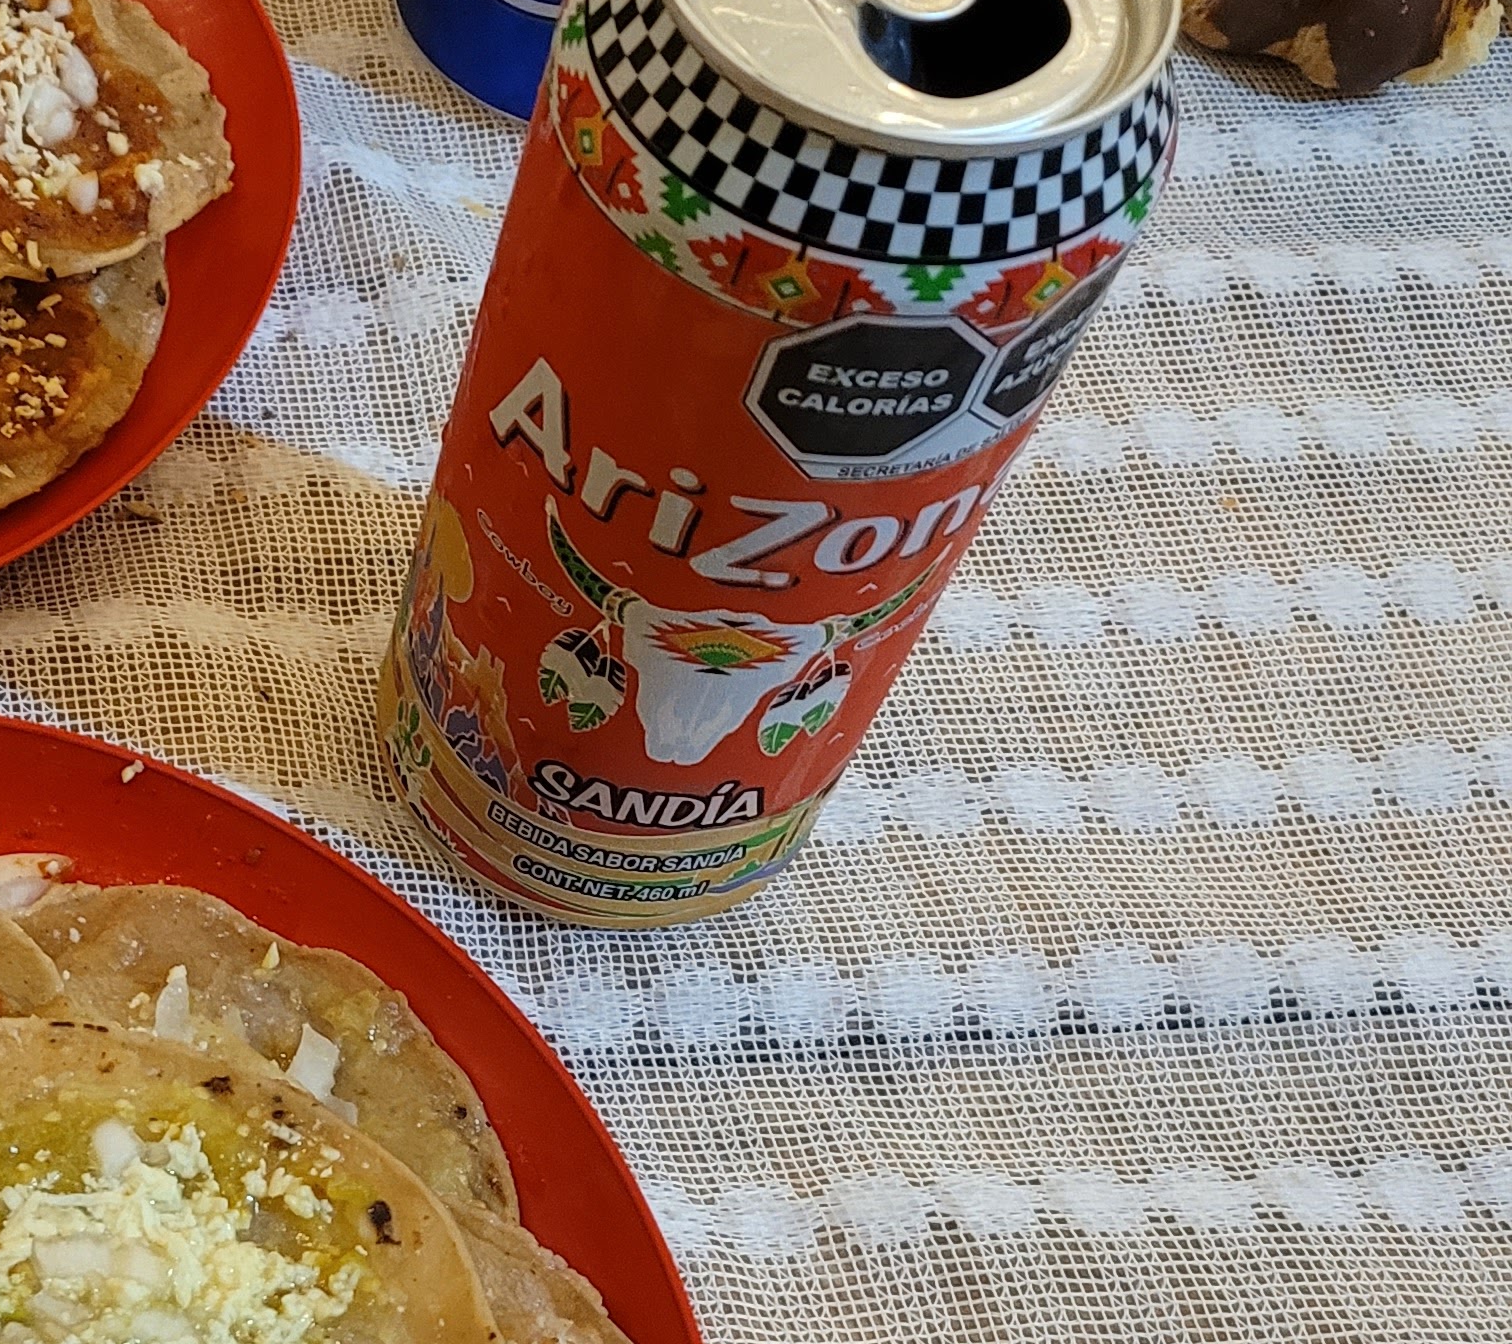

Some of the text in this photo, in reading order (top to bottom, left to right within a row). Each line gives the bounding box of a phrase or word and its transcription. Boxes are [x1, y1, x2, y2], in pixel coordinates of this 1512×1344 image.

[777, 387, 954, 416] CALORÍAS
[807, 363, 949, 389] EXCESO
[489, 357, 1004, 587] AriZon
[476, 508, 574, 617] Cowboy
[534, 764, 760, 828] SANDÍA
[490, 805, 745, 872] BEBIDA SABOR SANDÍA
[637, 888, 673, 901] 460
[678, 880, 706, 898] ml
